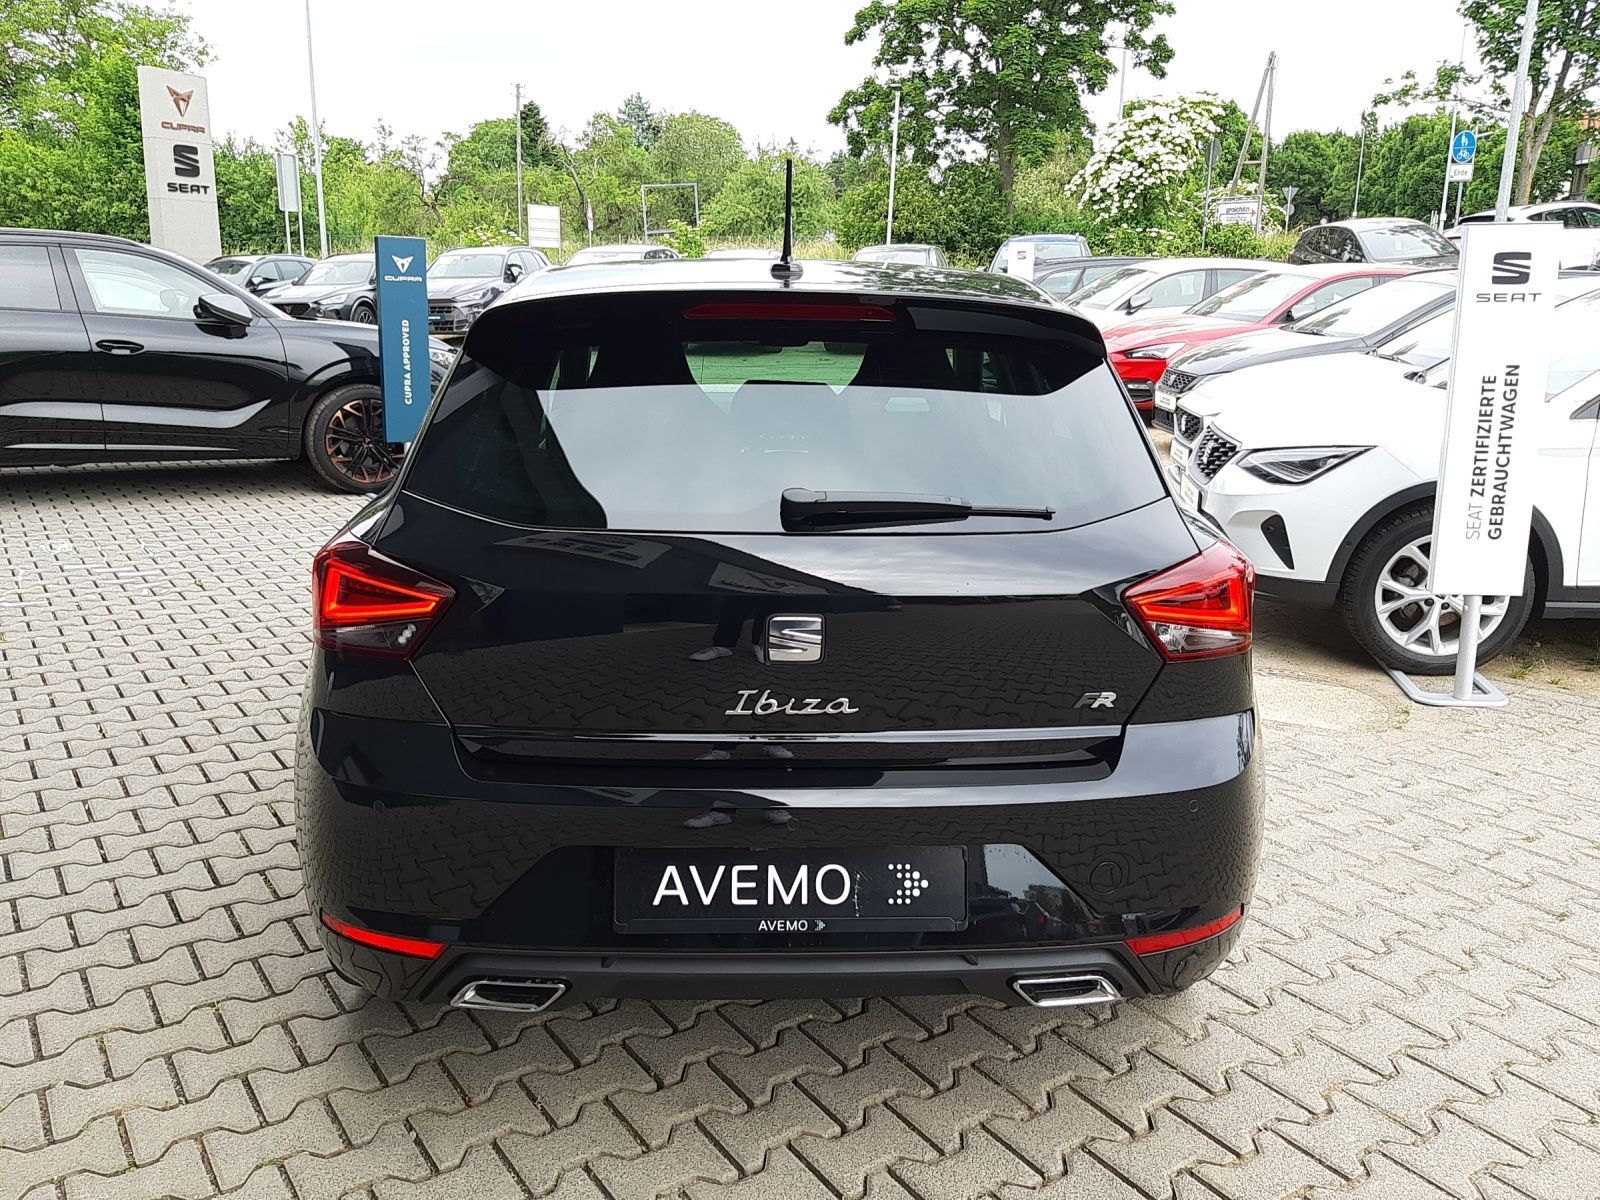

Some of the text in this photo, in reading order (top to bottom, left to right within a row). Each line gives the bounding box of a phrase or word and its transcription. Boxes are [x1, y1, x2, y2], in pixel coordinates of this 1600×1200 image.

[161, 121, 206, 134] CUPRA
[167, 182, 210, 195] SEAT
[384, 275, 422, 283] CUPRA
[1475, 292, 1542, 303] SEAT
[401, 319, 413, 405] CUPRA APPROVED
[1465, 375, 1497, 540] SEAT ZERTIFIZIERTE
[1487, 364, 1520, 540] GEBRAUCHTWAGEN
[725, 689, 859, 716] Ibiza
[1073, 691, 1117, 709] FR
[652, 864, 851, 906] AVEMO
[758, 919, 808, 932] AVEMO
